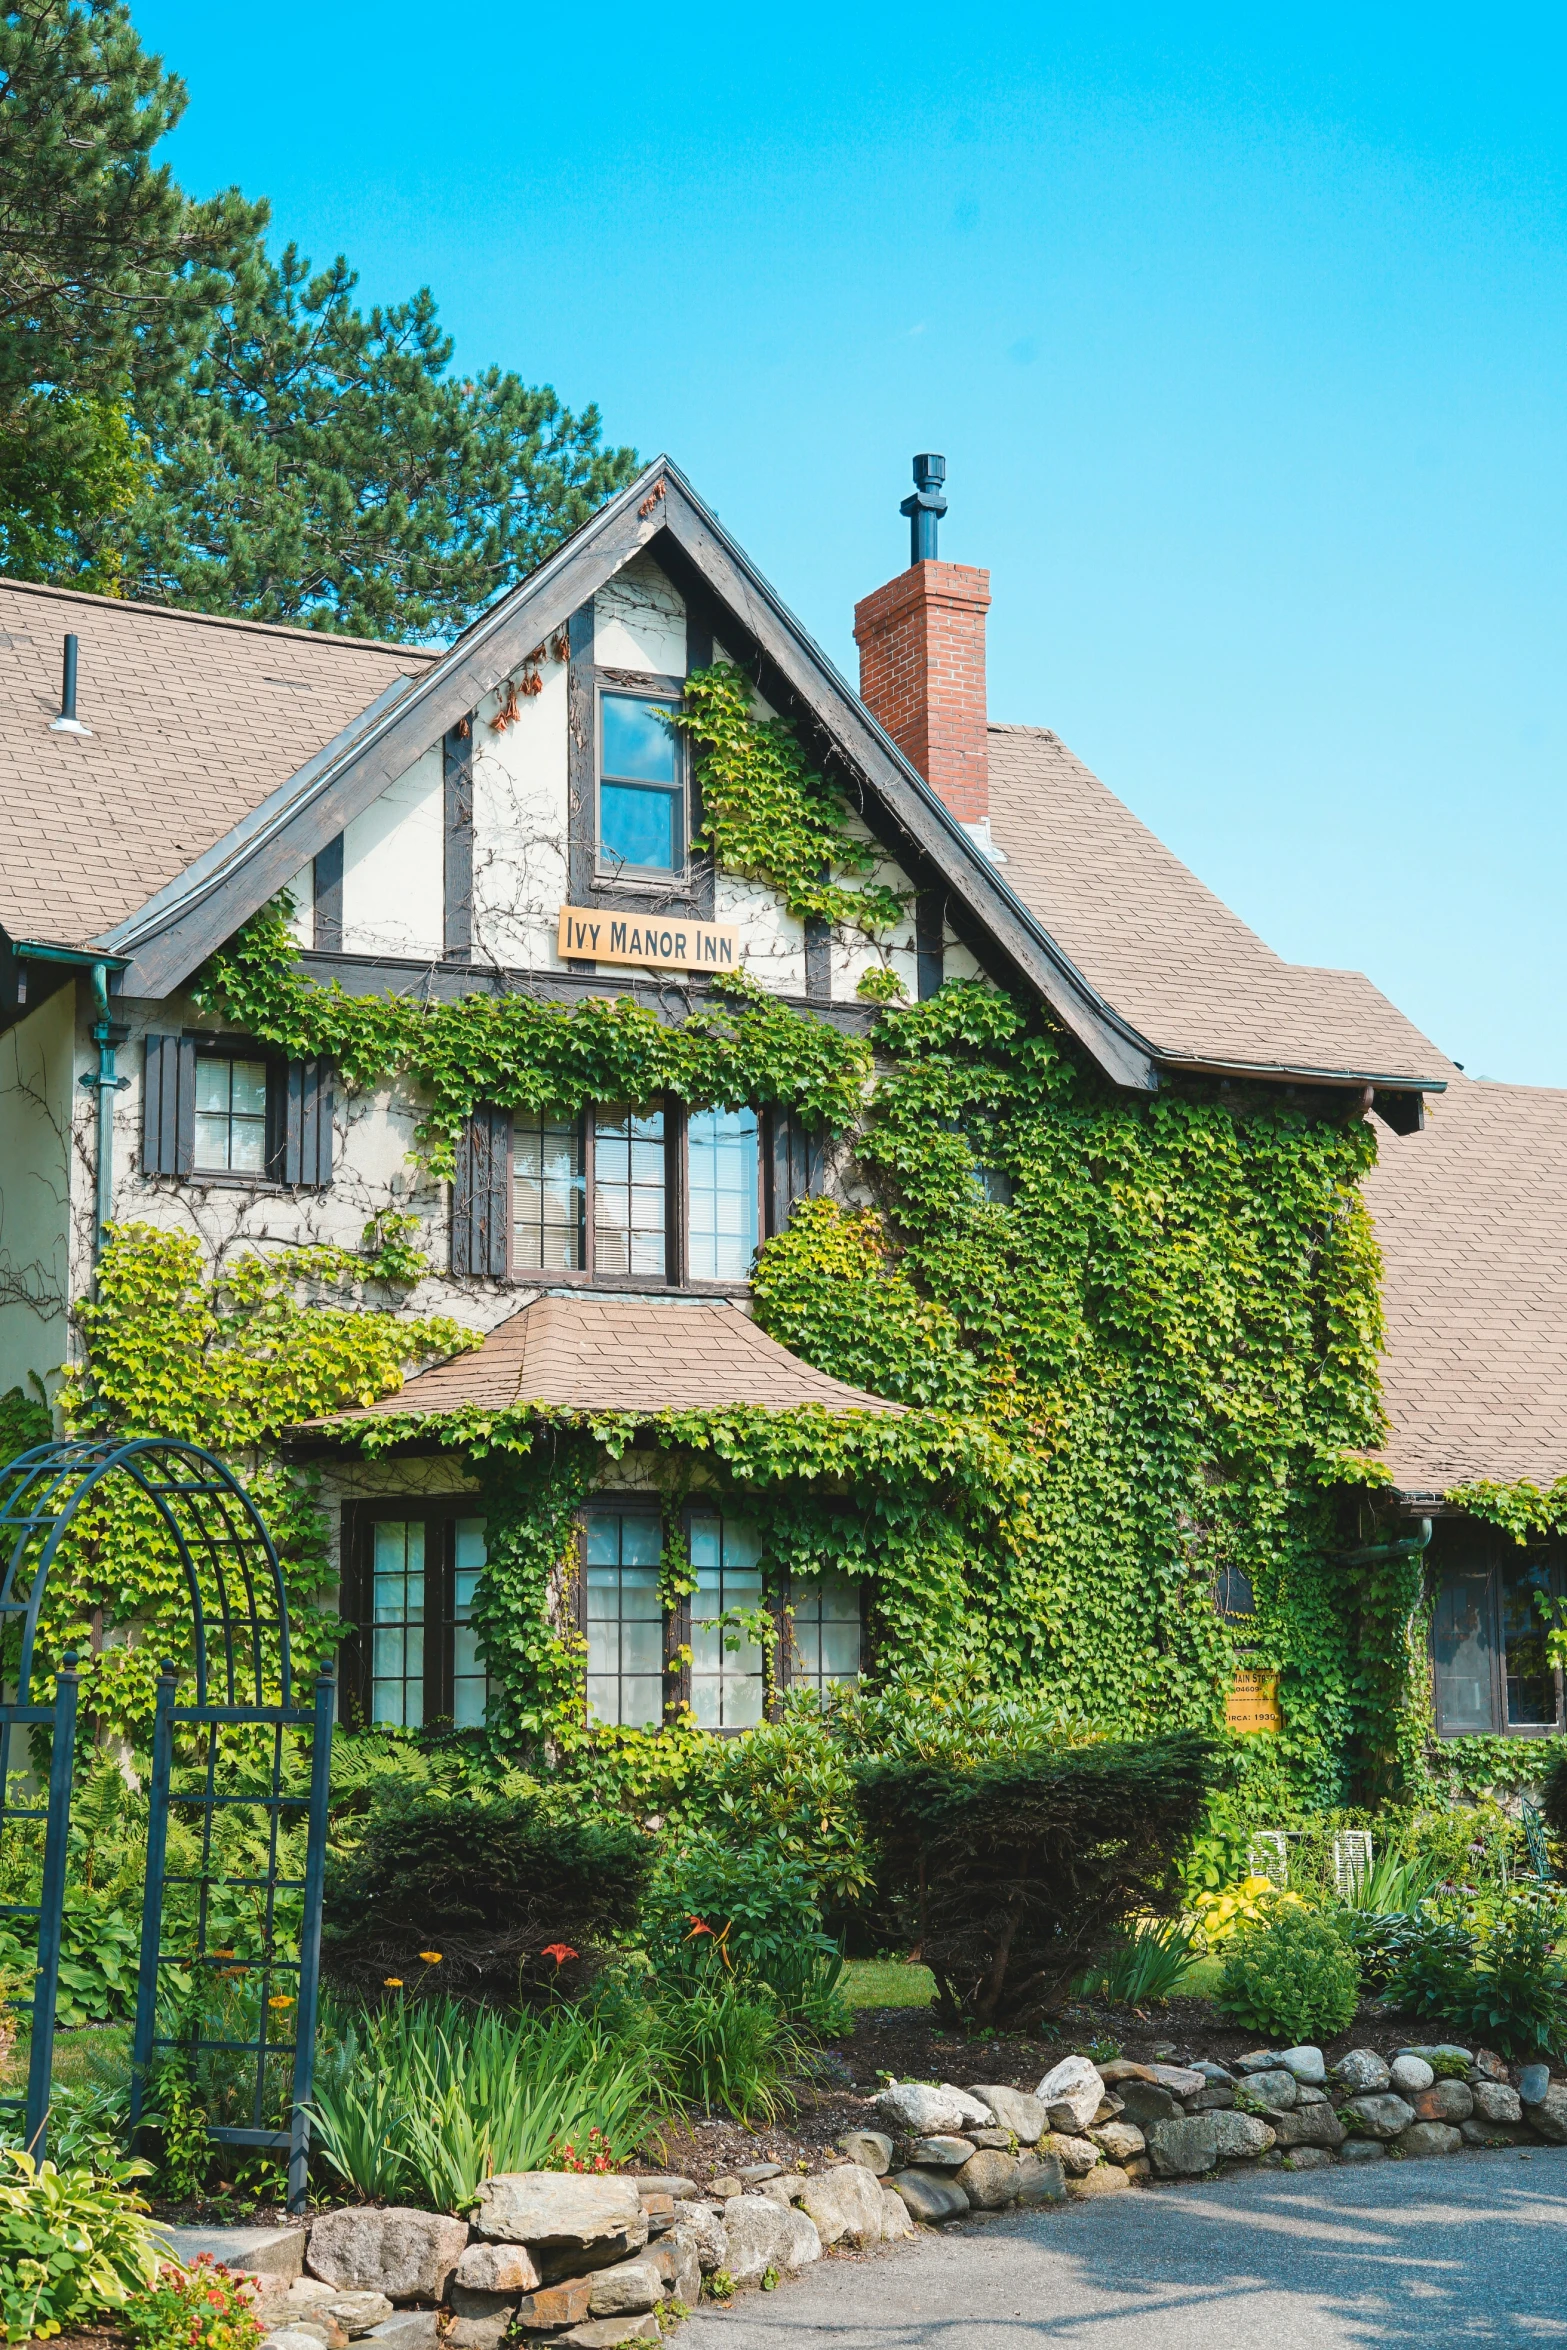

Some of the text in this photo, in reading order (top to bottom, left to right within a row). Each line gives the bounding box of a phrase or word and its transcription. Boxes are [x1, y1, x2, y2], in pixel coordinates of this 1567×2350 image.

[567, 917, 732, 964] IVY MANOR INN
[1252, 1673, 1279, 1683] STRT
[1254, 1713, 1276, 1721] 1939
